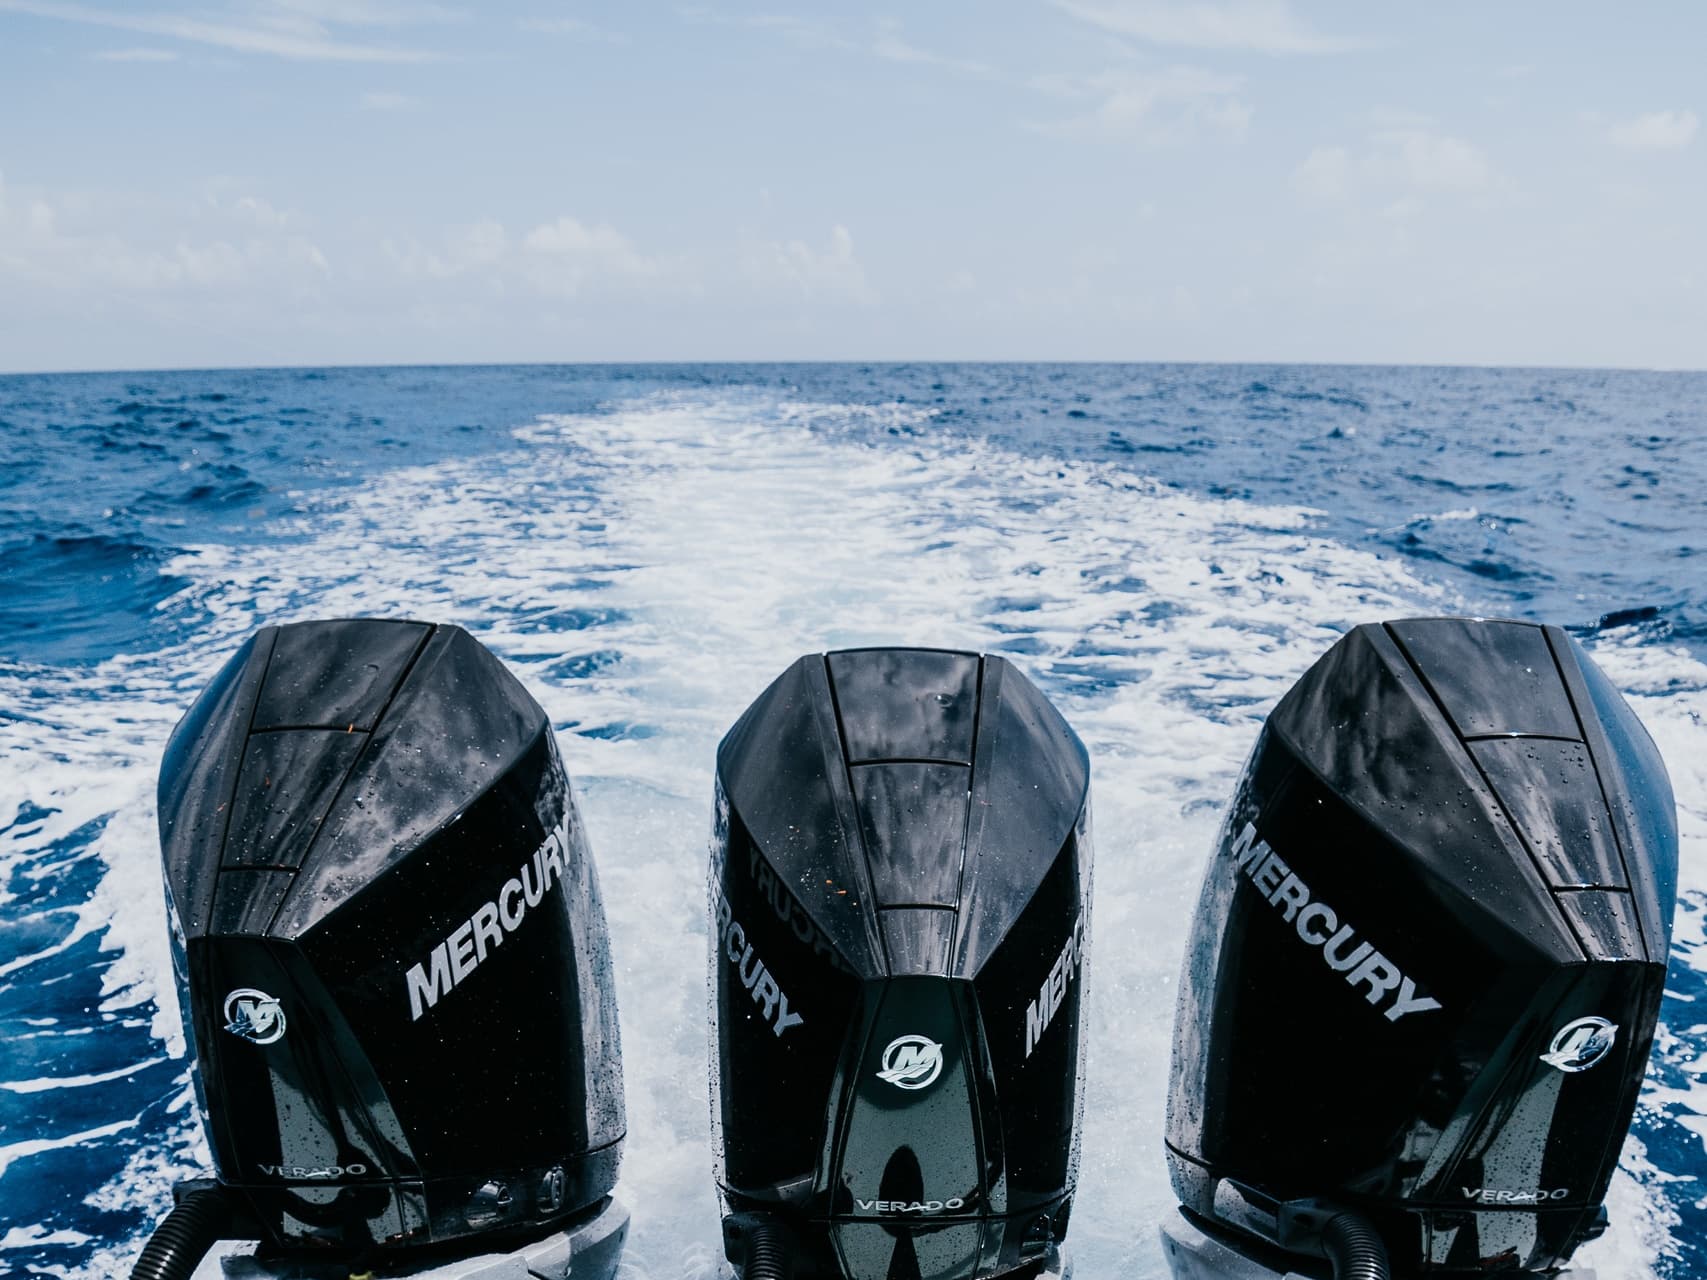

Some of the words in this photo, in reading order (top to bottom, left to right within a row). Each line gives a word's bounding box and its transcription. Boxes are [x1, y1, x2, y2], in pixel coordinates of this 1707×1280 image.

[405, 811, 570, 1022] MERCURY
[1231, 821, 1443, 1022] MERCURY
[257, 1163, 367, 1178] VERADO
[1461, 1186, 1569, 1201] VERADO
[855, 1197, 965, 1213] VERADO
